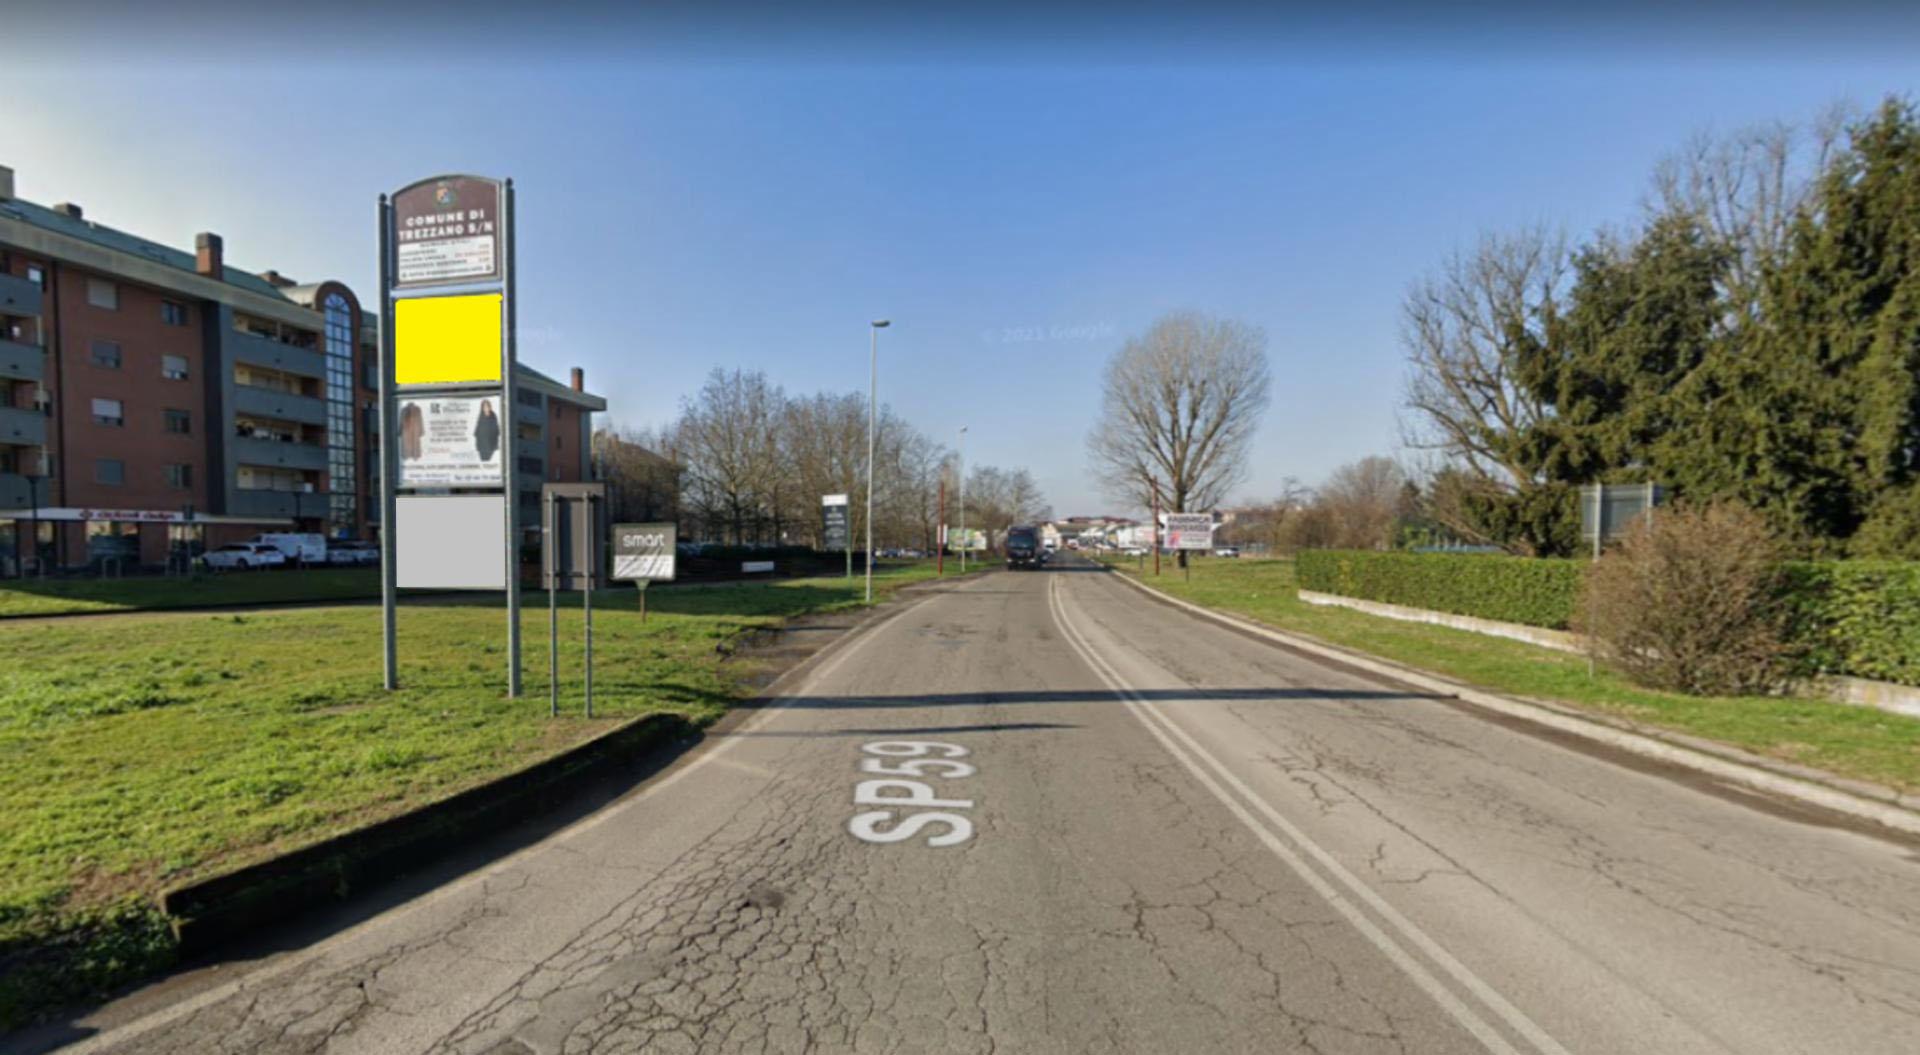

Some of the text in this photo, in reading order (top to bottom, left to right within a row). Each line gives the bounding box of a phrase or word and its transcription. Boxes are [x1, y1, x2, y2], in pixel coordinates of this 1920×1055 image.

[406, 208, 484, 227] COMUNE DI
[399, 221, 493, 240] TREZZANO S/N
[623, 533, 665, 548] smart
